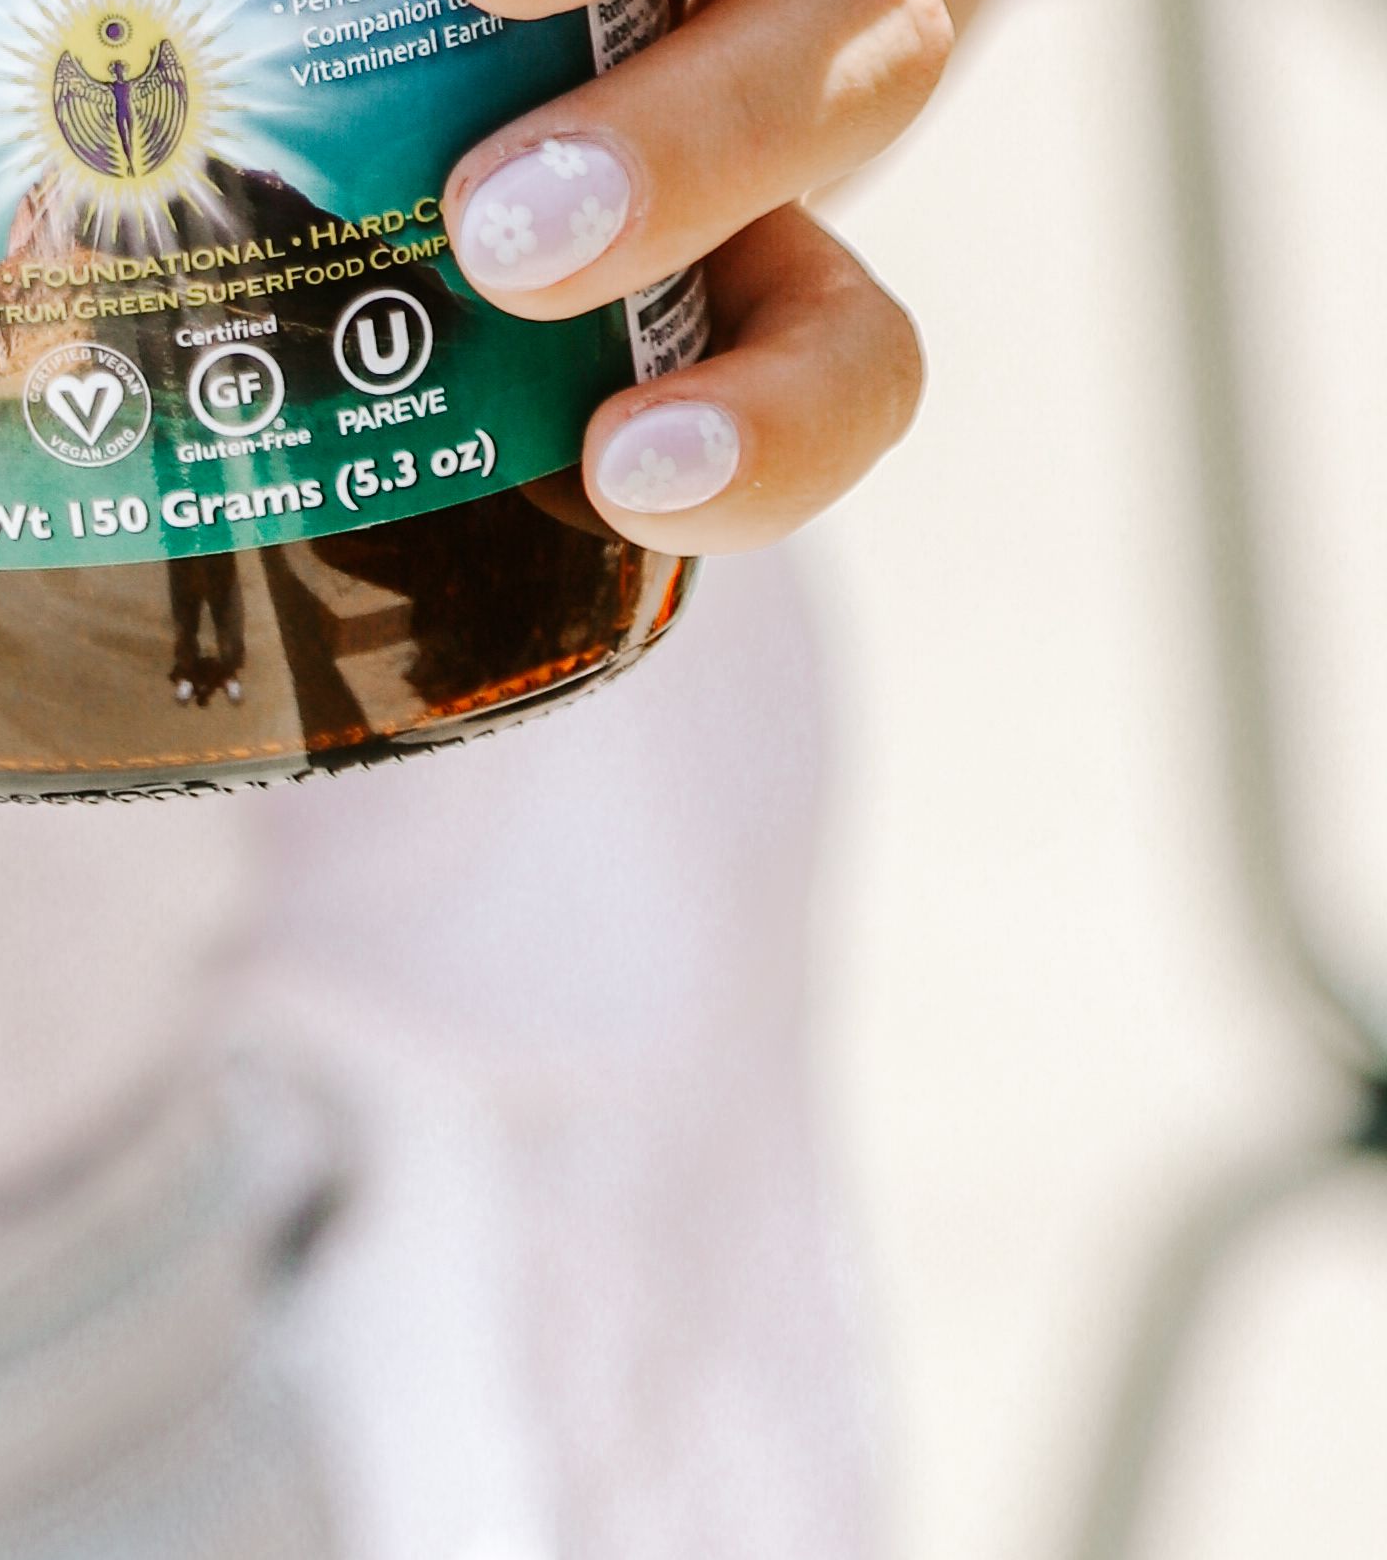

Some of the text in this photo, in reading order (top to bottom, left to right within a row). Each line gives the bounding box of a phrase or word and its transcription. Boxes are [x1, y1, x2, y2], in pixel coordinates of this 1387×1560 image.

[289, 14, 504, 88] Vitamineral Earth
[20, 238, 286, 290] FOUNDATIONAL
[310, 196, 445, 250] HARD-C
[73, 291, 179, 321] GREEN
[186, 256, 365, 308] SUPERFOOD
[369, 234, 450, 271] COMP
[176, 314, 279, 348] Certified
[356, 310, 411, 376] U
[29, 347, 144, 403] CERTIFIED VEGAN
[207, 371, 263, 410] GF
[337, 387, 448, 436] PAREVE
[50, 427, 136, 462] VEGAN.ORG
[177, 428, 312, 464] Gluten-Free
[69, 499, 149, 540] 150
[160, 476, 325, 529] Grams
[335, 450, 419, 513] (5.3
[431, 429, 498, 480] oz)
